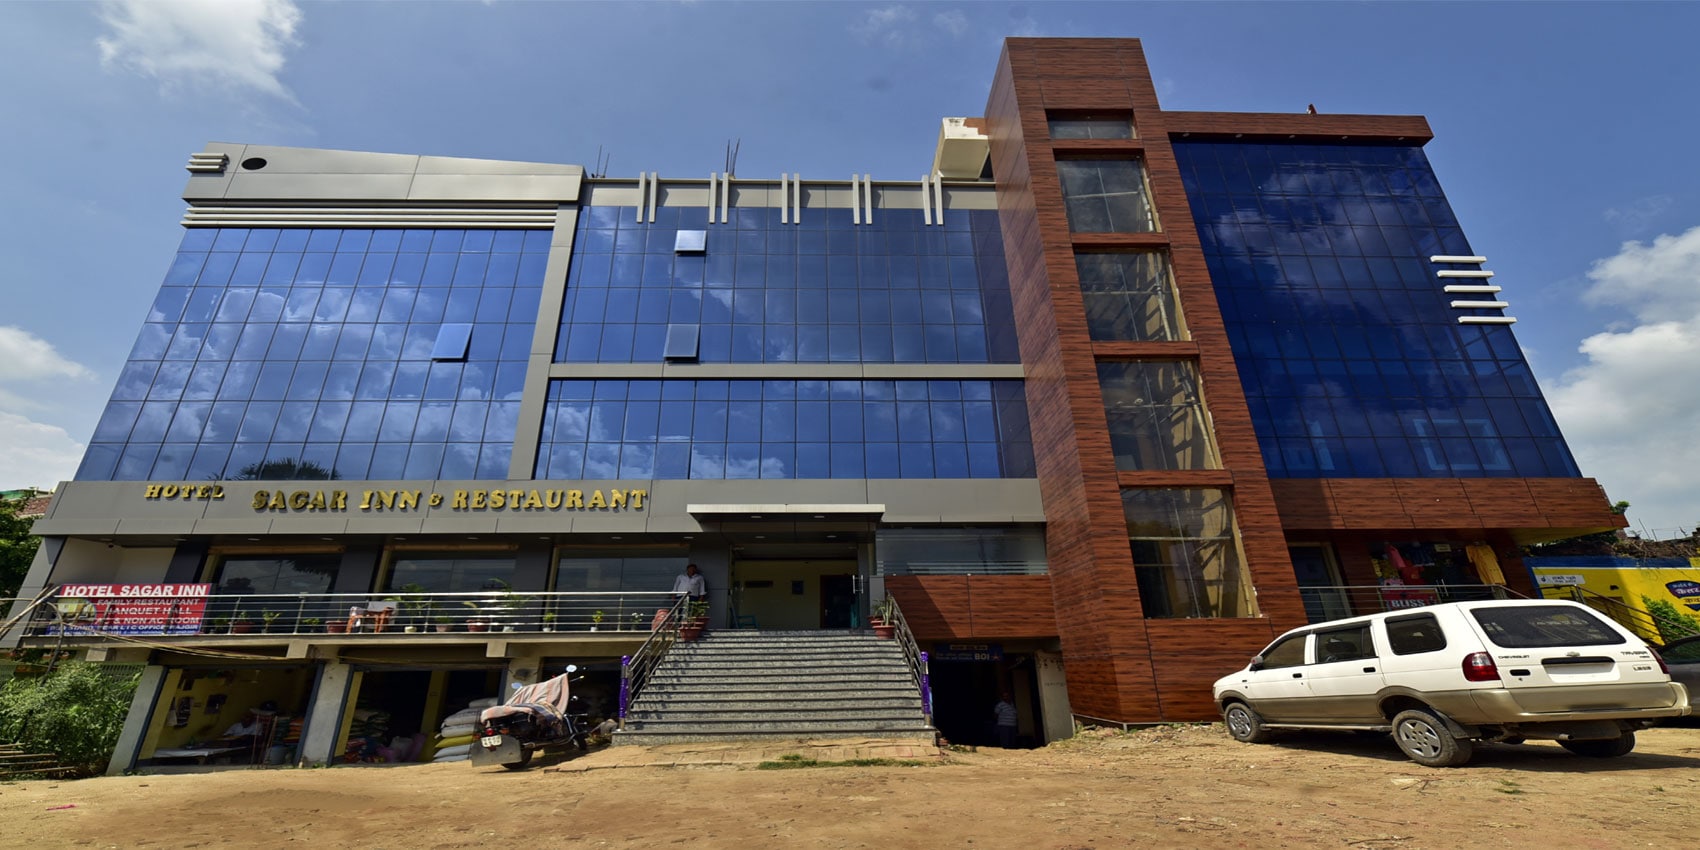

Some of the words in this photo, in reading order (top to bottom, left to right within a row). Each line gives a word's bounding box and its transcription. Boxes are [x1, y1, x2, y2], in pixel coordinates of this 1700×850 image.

[143, 484, 225, 499] HOTEL
[252, 489, 348, 510] SAGAR
[359, 489, 421, 510] INN
[452, 489, 648, 509] RESTAURANT
[63, 585, 115, 597] HOTEL
[120, 585, 175, 597] SAGAR
[177, 585, 207, 597] INN
[1391, 599, 1425, 608] BLISS
